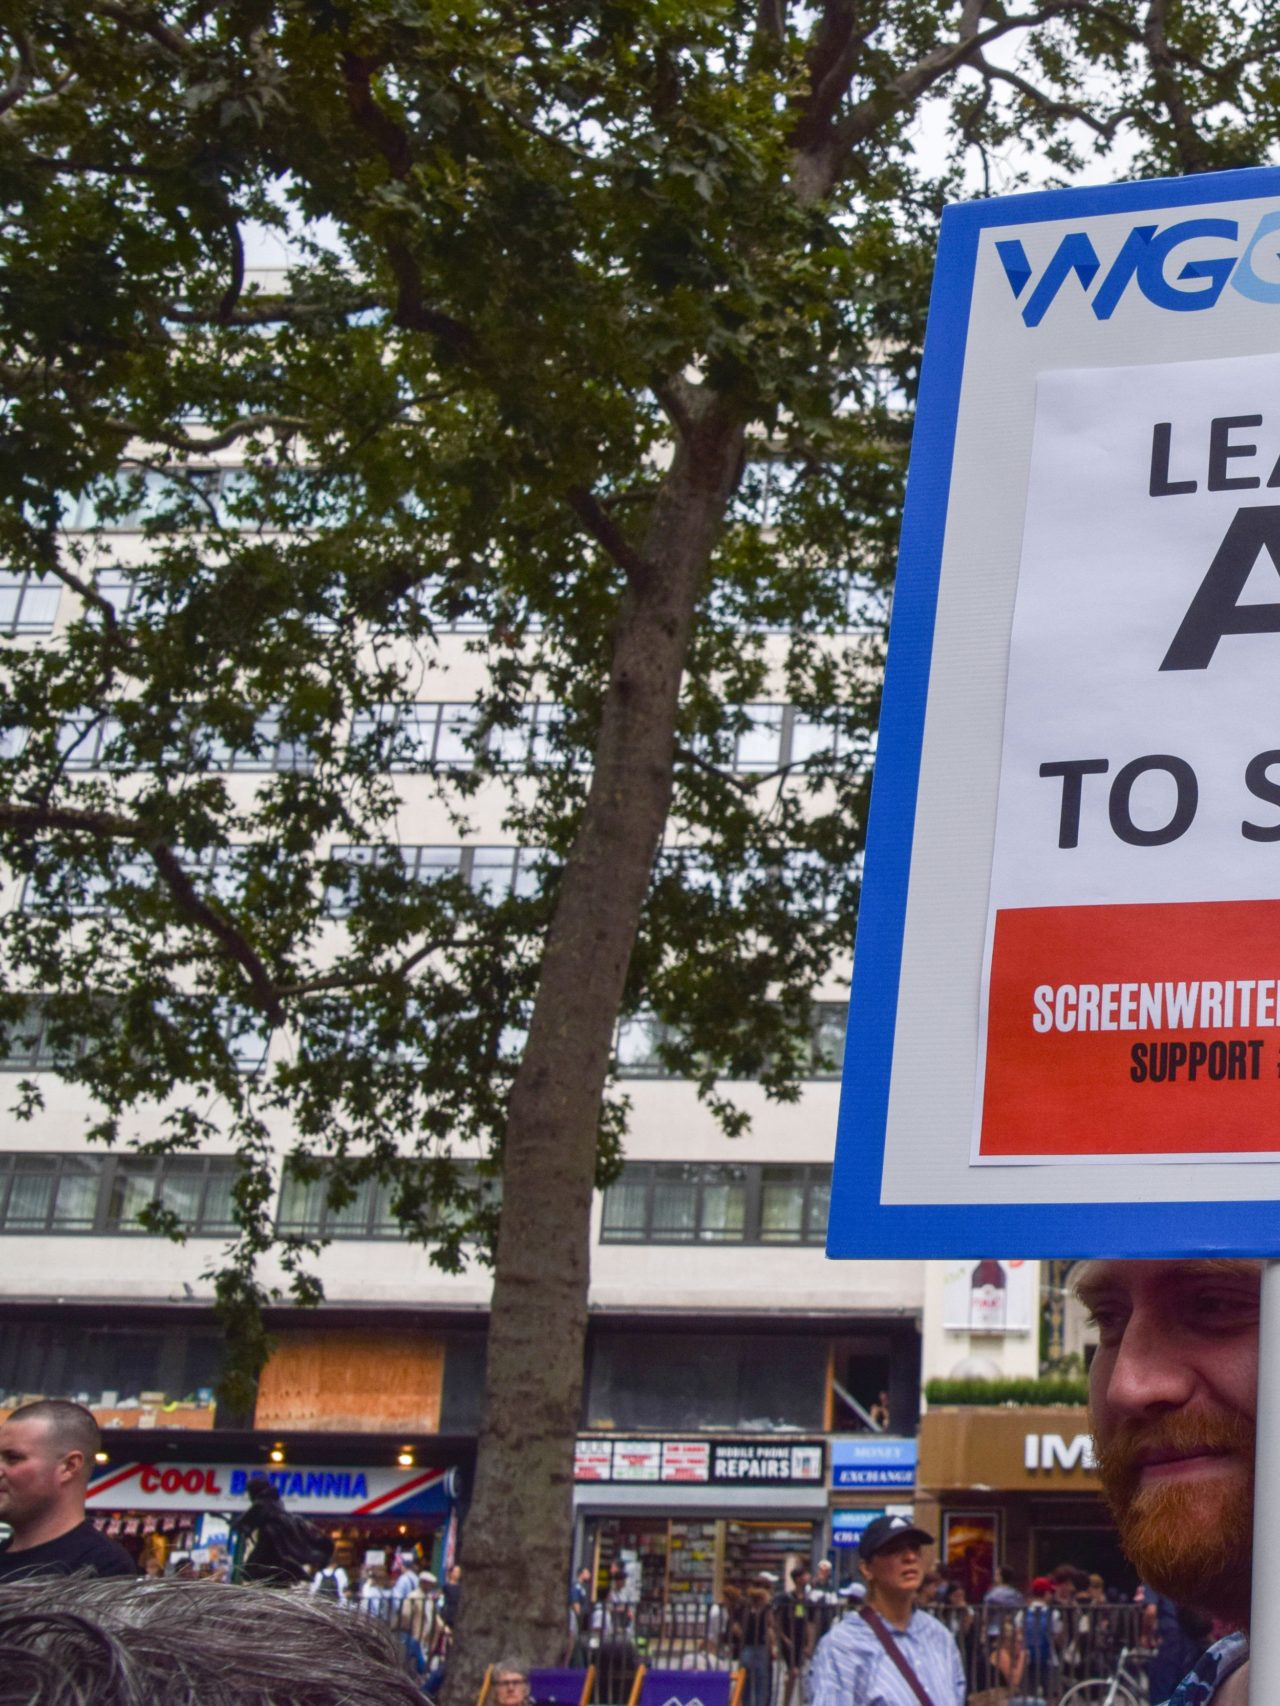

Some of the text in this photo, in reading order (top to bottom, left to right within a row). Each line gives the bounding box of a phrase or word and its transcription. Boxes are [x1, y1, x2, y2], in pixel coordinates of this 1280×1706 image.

[1038, 754, 1199, 850] TO
[1129, 1040, 1264, 1084] SUPPORT
[715, 1446, 790, 1458] MOBILE PHONE
[853, 1447, 904, 1458] MONEY
[714, 1459, 790, 1478] REPAIRS
[839, 1470, 915, 1484] EXCHANGE
[140, 1468, 222, 1494] COOL
